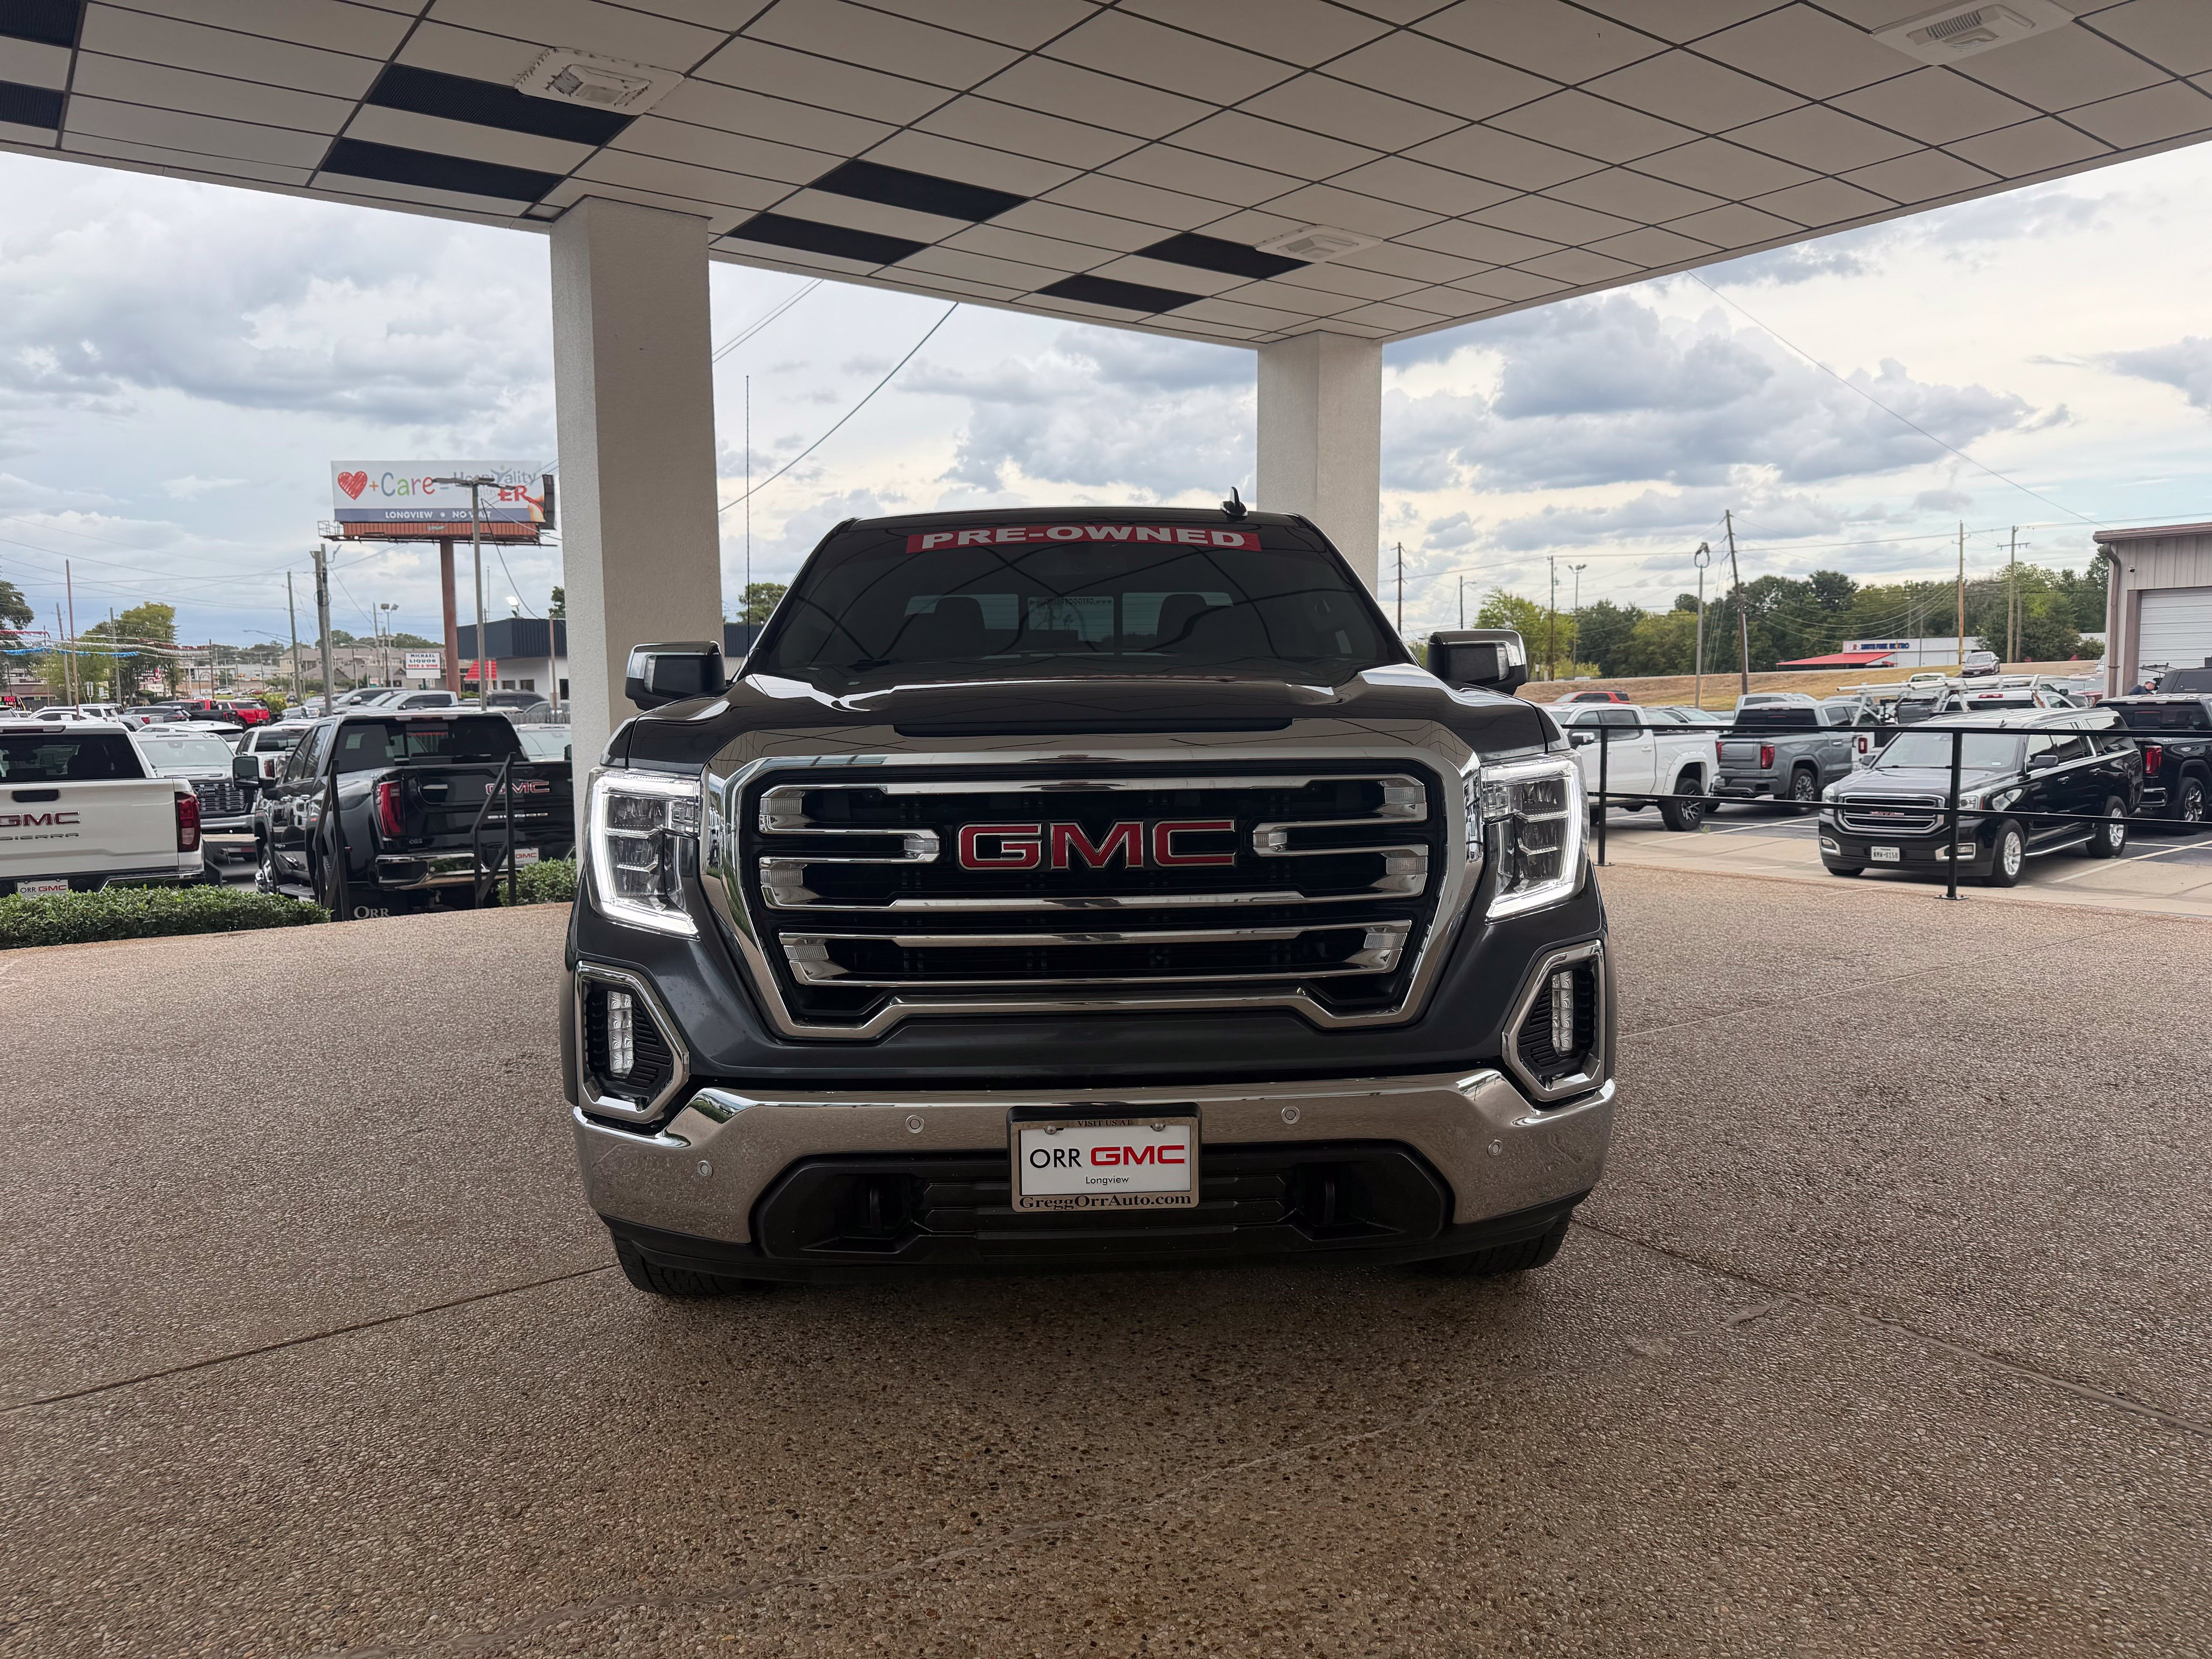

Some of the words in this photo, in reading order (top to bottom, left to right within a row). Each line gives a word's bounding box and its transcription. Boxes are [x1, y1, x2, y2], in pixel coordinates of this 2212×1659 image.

[381, 472, 435, 497] Care
[497, 485, 528, 502] ER
[921, 525, 1245, 549] PRE-OWNED
[485, 781, 550, 795] GMC
[0, 811, 80, 827] GMC
[958, 819, 1236, 870] GMC
[354, 906, 389, 919] ORR
[1029, 1148, 1082, 1169] ORR
[1090, 1144, 1185, 1166] GMC
[1085, 1175, 1129, 1185] Longview
[1019, 1194, 1192, 1210] GreggOrrAuto.com
